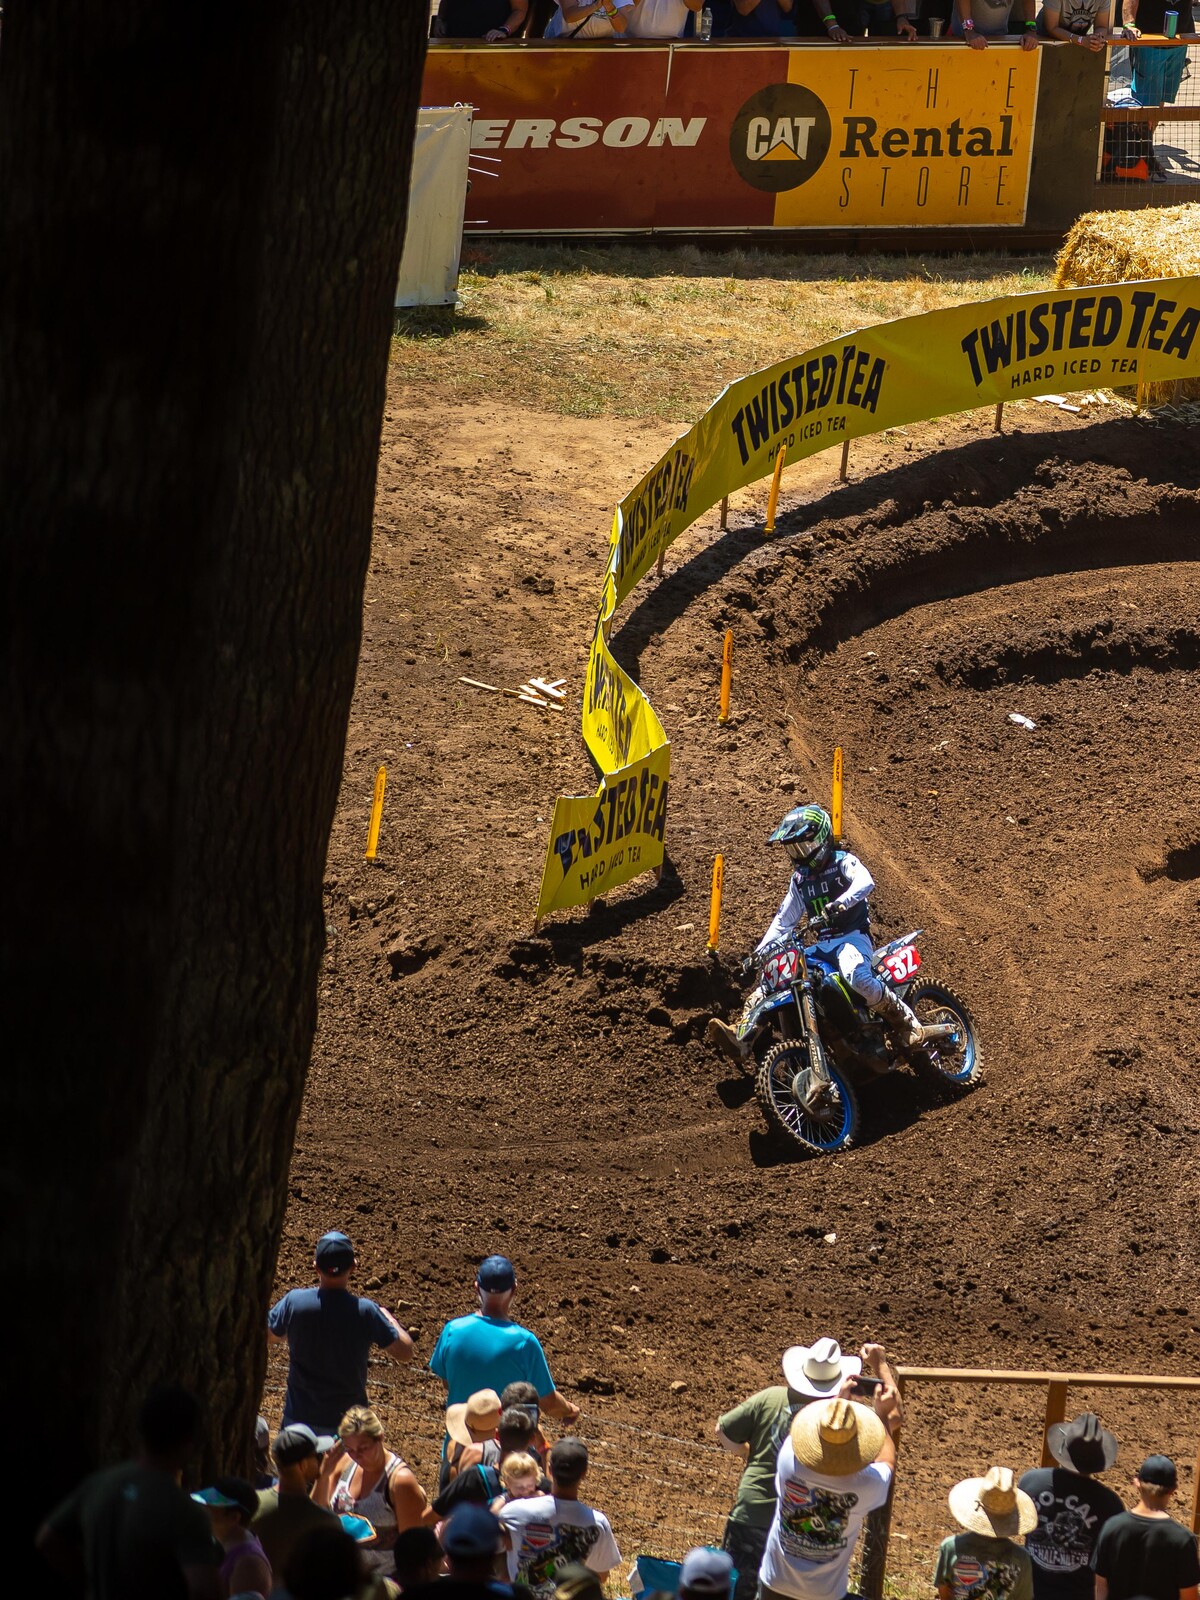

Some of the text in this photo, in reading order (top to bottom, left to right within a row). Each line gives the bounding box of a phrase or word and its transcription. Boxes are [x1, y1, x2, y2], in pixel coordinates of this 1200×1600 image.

[849, 68, 1017, 109] THE
[470, 117, 707, 149] ERSON
[746, 116, 816, 161] CAT
[840, 115, 1014, 158] Rental
[839, 165, 1008, 207] STORE
[961, 296, 1123, 387] TWISTED
[1011, 358, 1138, 389] HARD ICED TEA
[731, 345, 886, 467] TWISTED TEA
[800, 420, 822, 442] ICED
[827, 416, 846, 432] TEA
[580, 860, 606, 890] HARD
[628, 845, 641, 864] TEA
[764, 950, 797, 988] 32
[887, 949, 919, 981] 32
